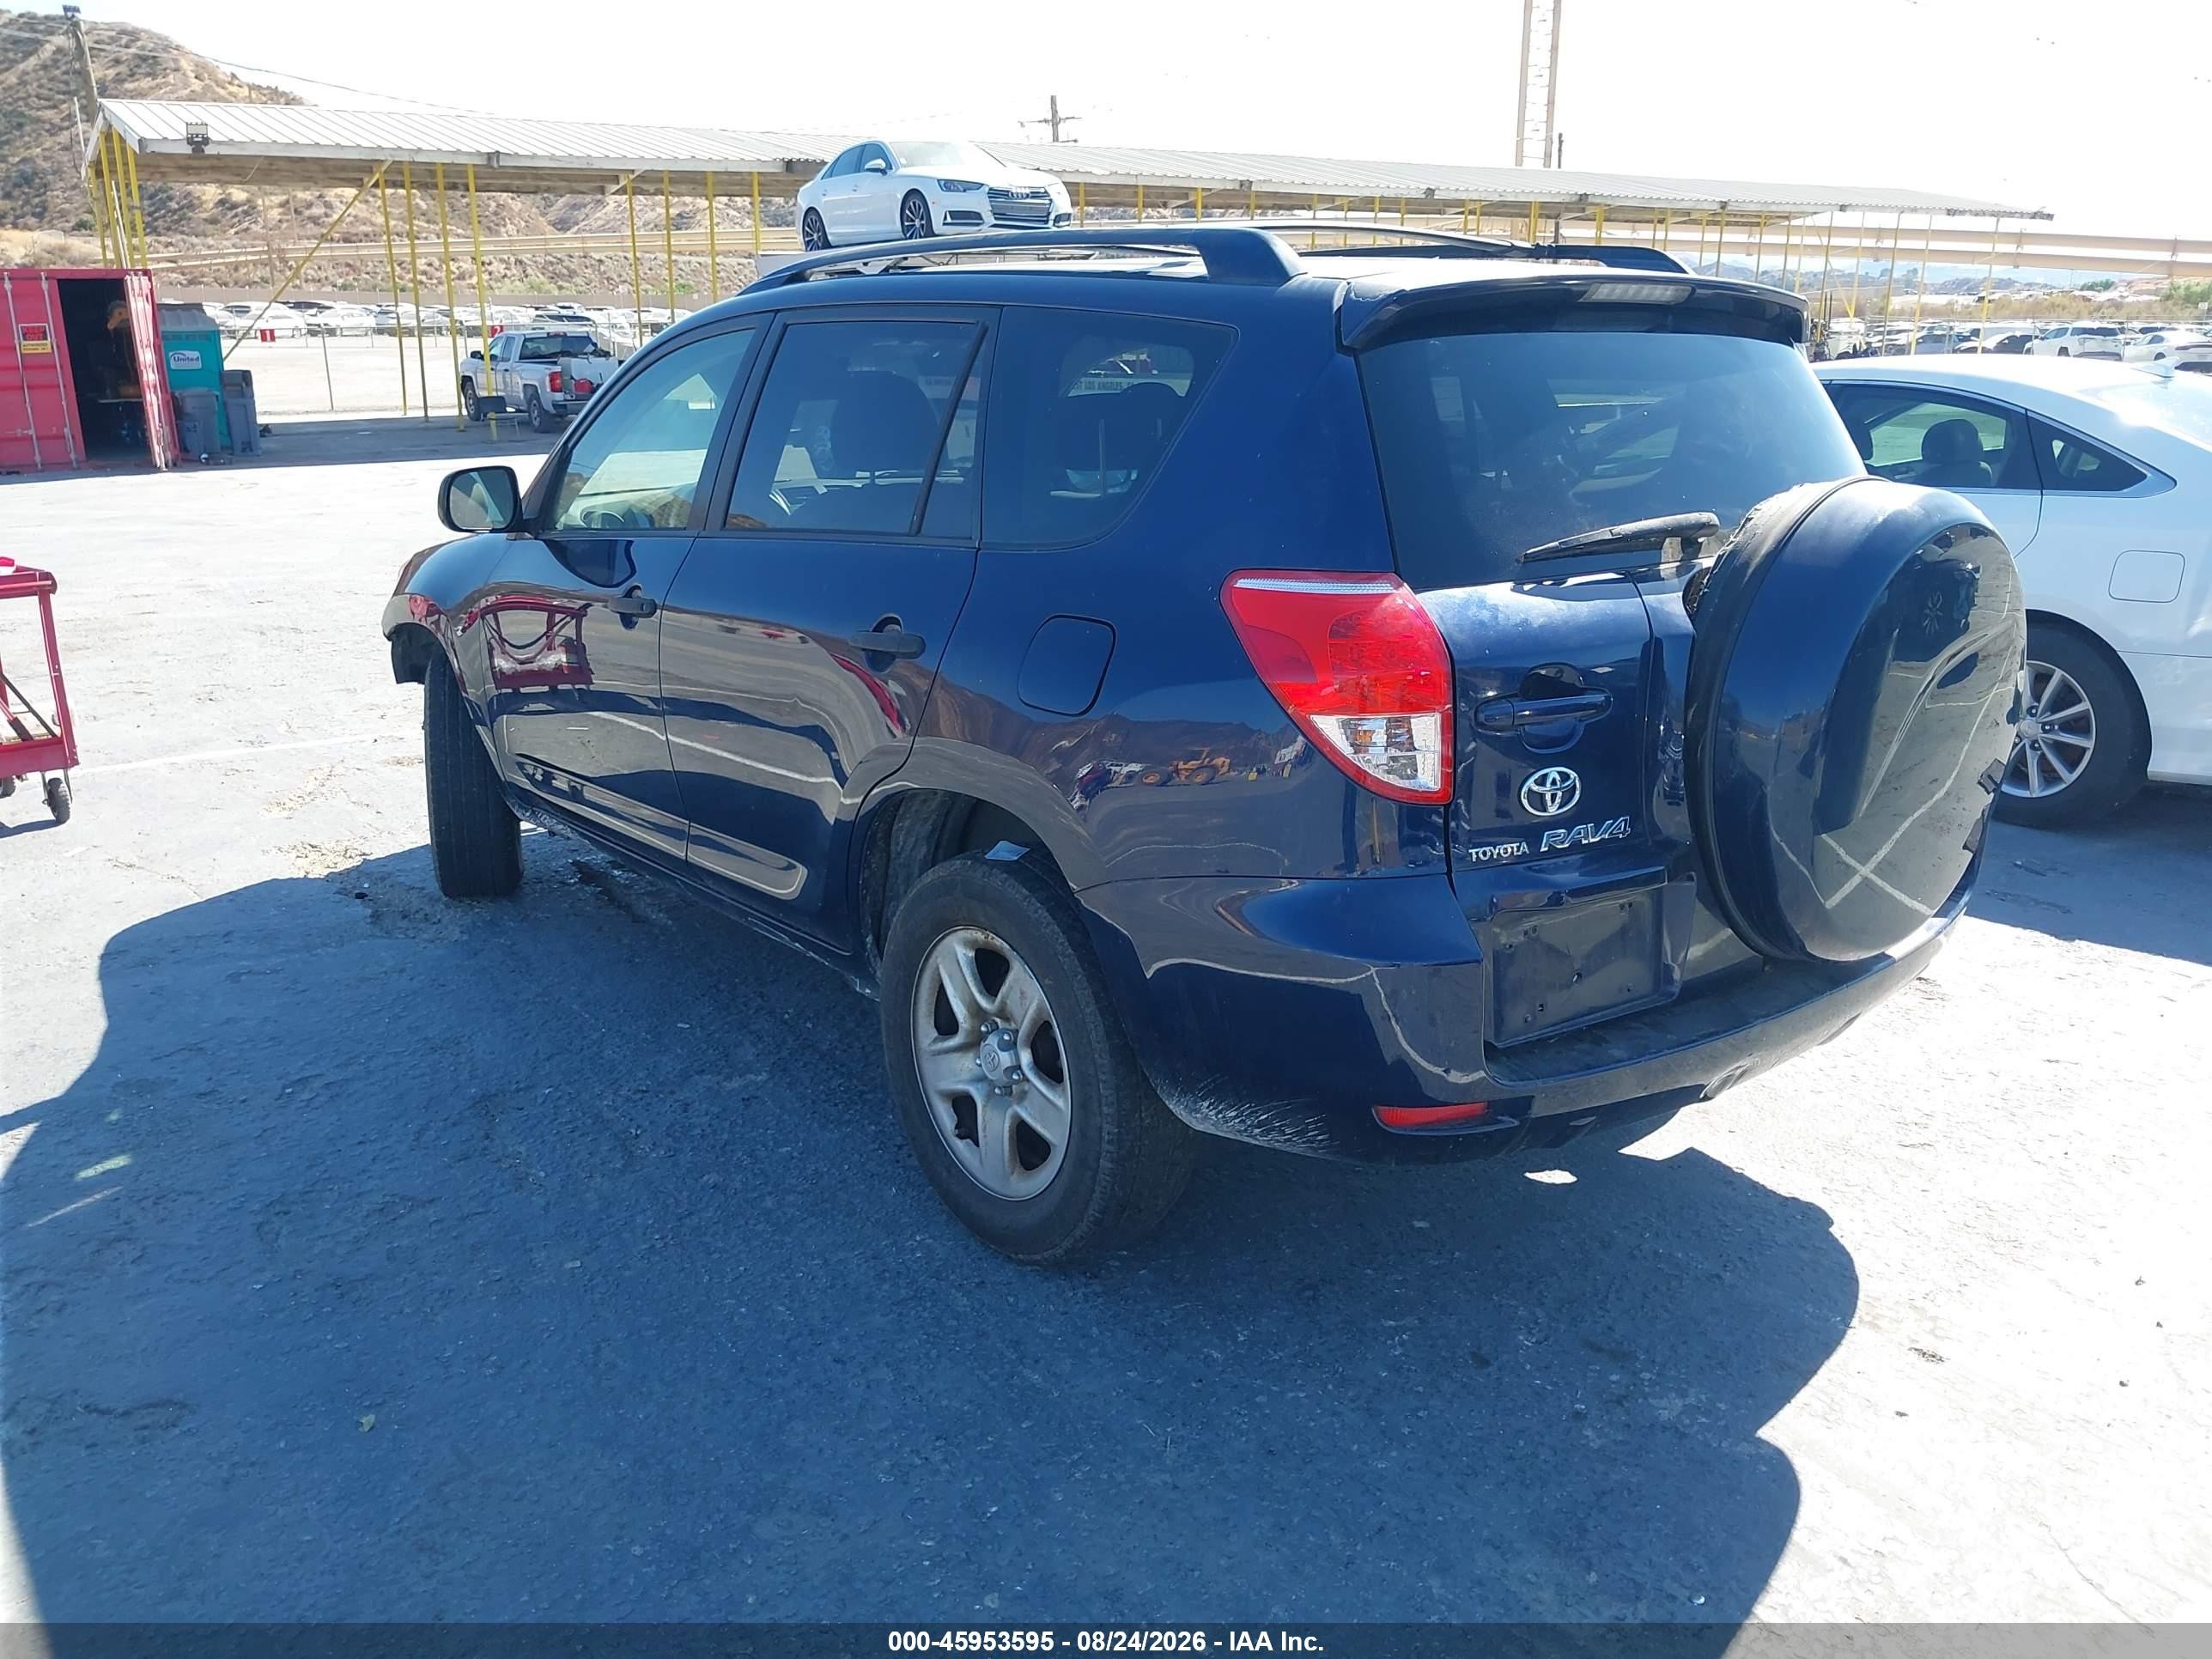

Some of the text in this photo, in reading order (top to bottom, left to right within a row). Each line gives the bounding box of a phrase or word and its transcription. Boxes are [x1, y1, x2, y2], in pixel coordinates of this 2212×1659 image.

[265, 330, 271, 342] 1
[494, 325, 501, 337] 2
[173, 355, 200, 363] United
[1469, 816, 1631, 862] TOYOTA RAV4
